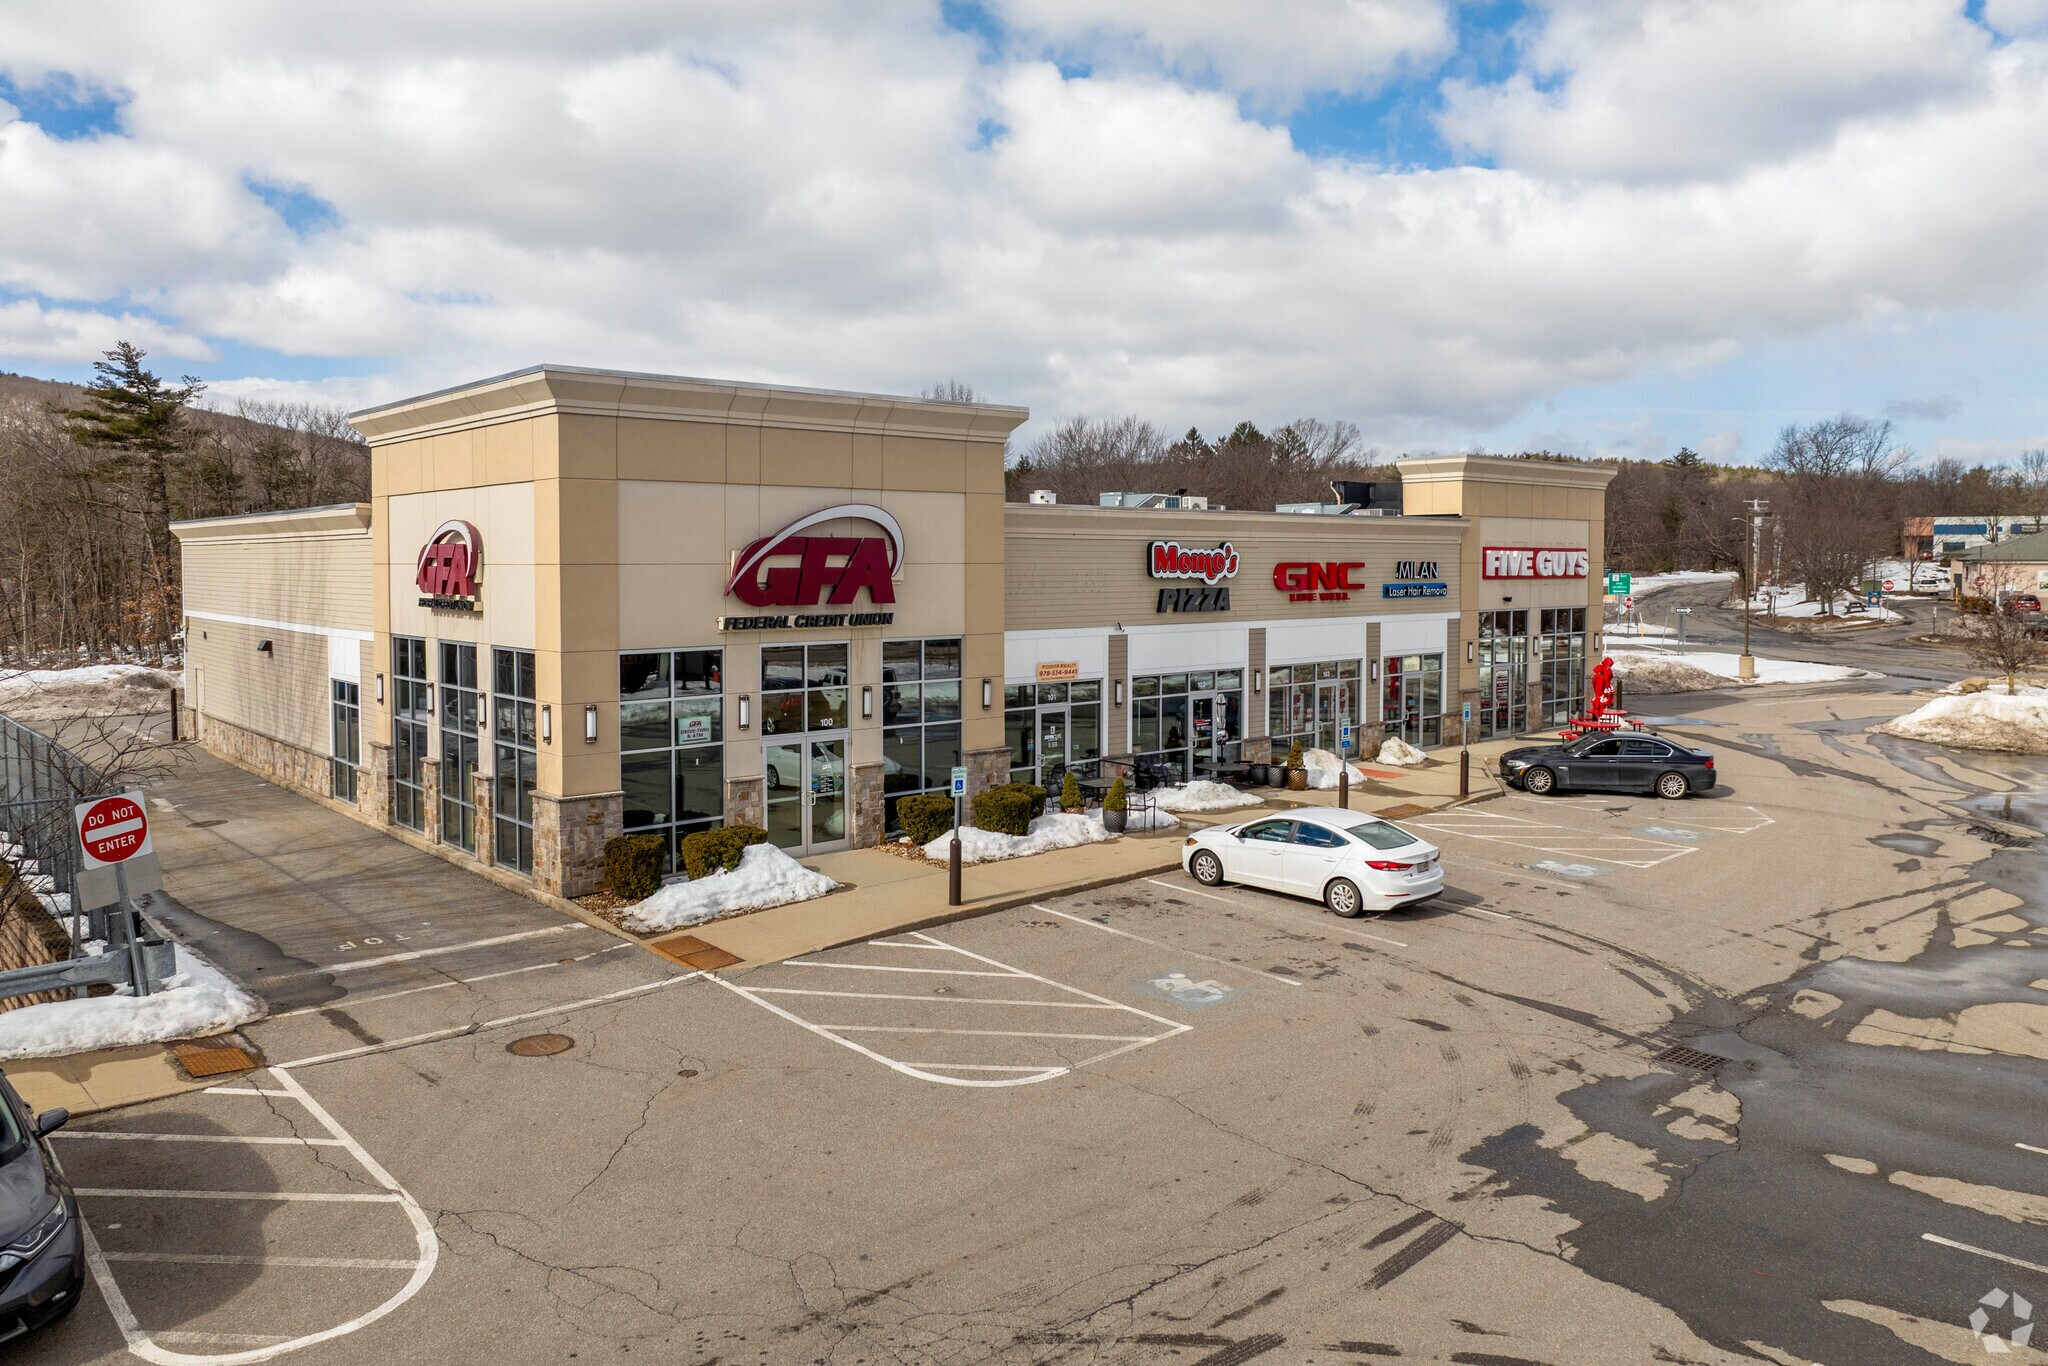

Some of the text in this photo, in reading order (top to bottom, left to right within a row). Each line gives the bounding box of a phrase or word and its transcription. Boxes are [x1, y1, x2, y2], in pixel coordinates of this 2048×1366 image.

[416, 543, 475, 597] GFA
[733, 536, 896, 607] GFA
[1153, 544, 1238, 581] Momo's
[1396, 561, 1439, 579] MILAN
[1485, 549, 1590, 577] FIVE GUYS
[1273, 562, 1365, 591] GNC
[1157, 587, 1230, 613] PIZZA
[1389, 587, 1407, 597] Laser
[1407, 586, 1422, 596] Hair
[724, 612, 894, 630] FEDERAL CREDIT UNION
[1047, 693, 1057, 701] 101
[680, 727, 710, 735] DRIVE-THRU
[820, 717, 833, 727] 100
[88, 805, 134, 827] DO NOT
[98, 834, 136, 853] ENTER
